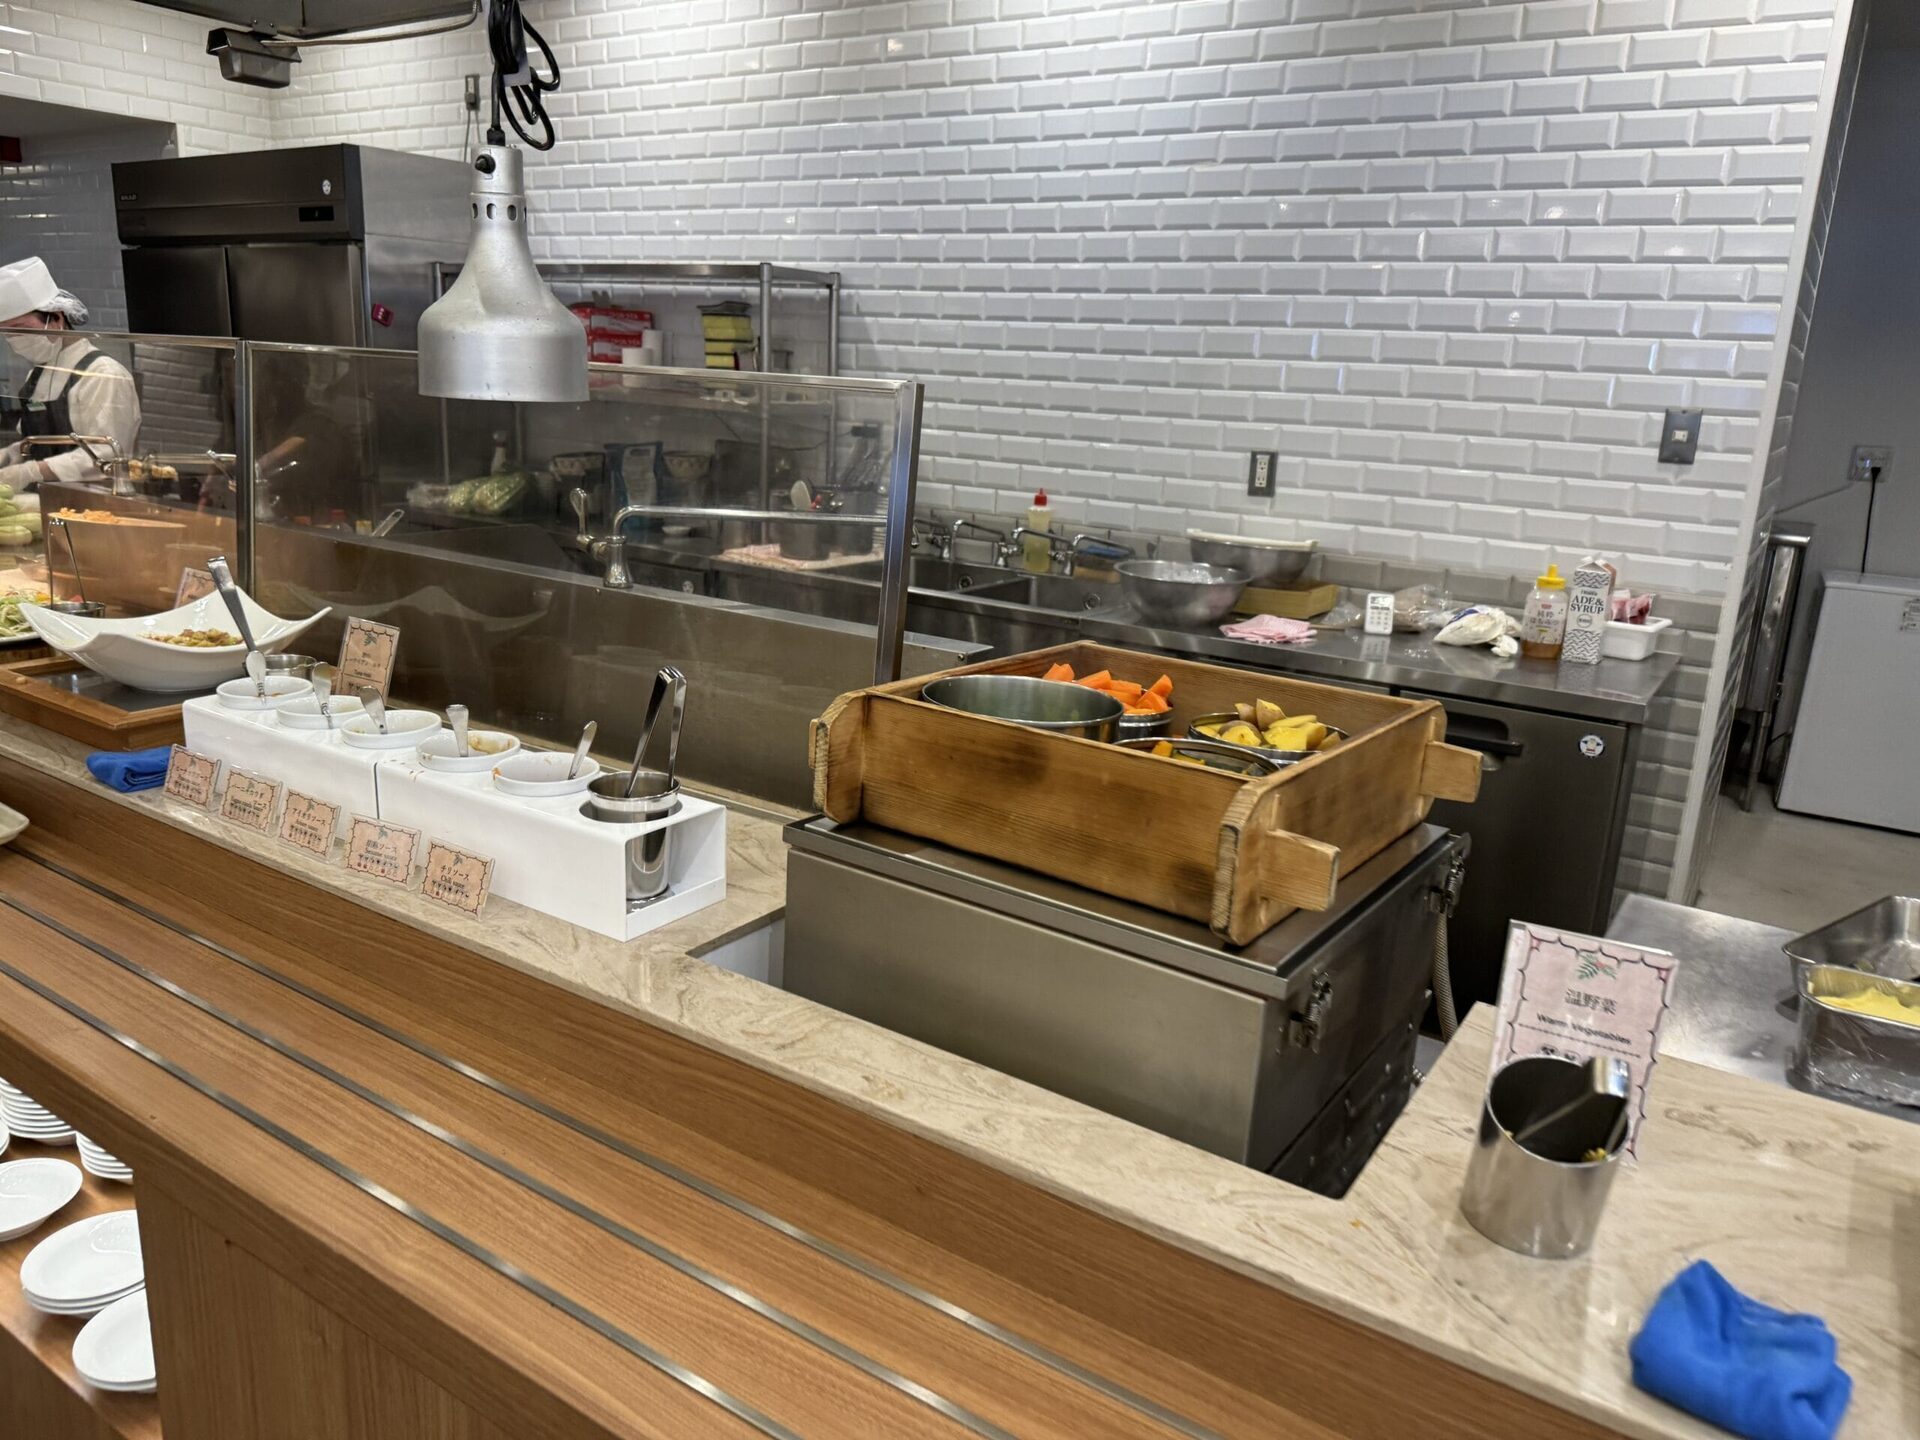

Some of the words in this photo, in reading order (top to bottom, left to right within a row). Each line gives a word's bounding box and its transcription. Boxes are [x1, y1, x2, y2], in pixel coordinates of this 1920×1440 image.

[1570, 603, 1604, 614] SYRUP
[1565, 988, 1618, 1015] 温野菜
[1537, 1013, 1568, 1028] Warm
